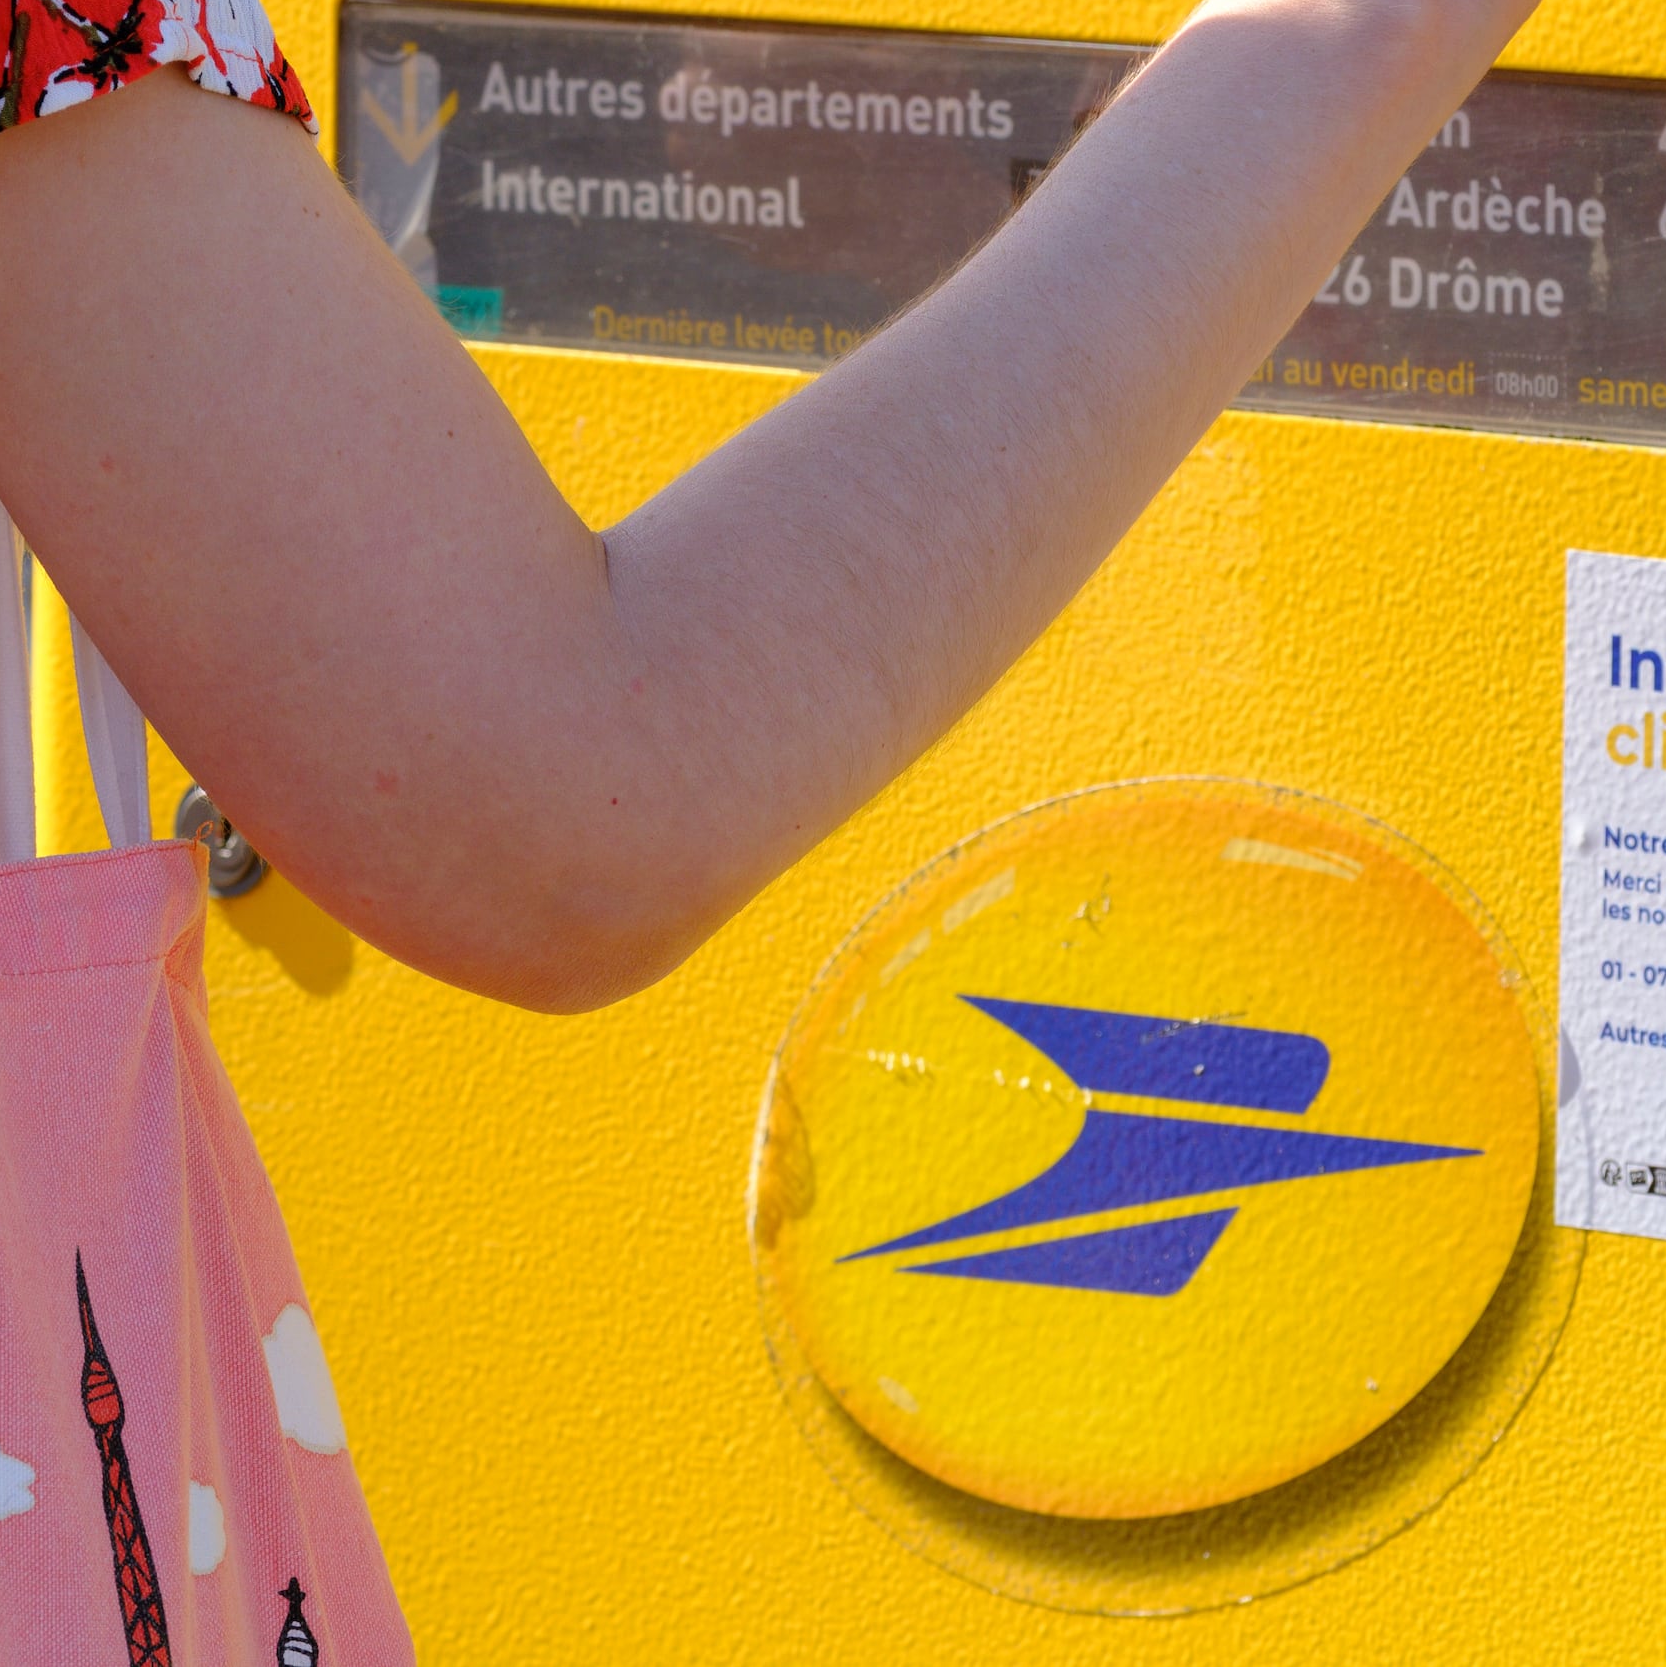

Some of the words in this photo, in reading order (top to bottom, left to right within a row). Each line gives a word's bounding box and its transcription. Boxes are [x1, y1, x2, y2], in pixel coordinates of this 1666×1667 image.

[480, 60, 646, 120] Autres
[658, 68, 1015, 139] départements
[482, 160, 805, 230] International
[1386, 175, 1607, 238] Ardèche
[1390, 256, 1565, 318] Drôme
[592, 304, 727, 347] Dernière
[735, 313, 816, 353] levée
[1282, 357, 1323, 386] au
[1330, 357, 1475, 397] vendredi
[1494, 371, 1559, 400] 08h00
[1603, 868, 1662, 894] Merci
[1602, 898, 1631, 921] les
[1601, 960, 1623, 981] 01
